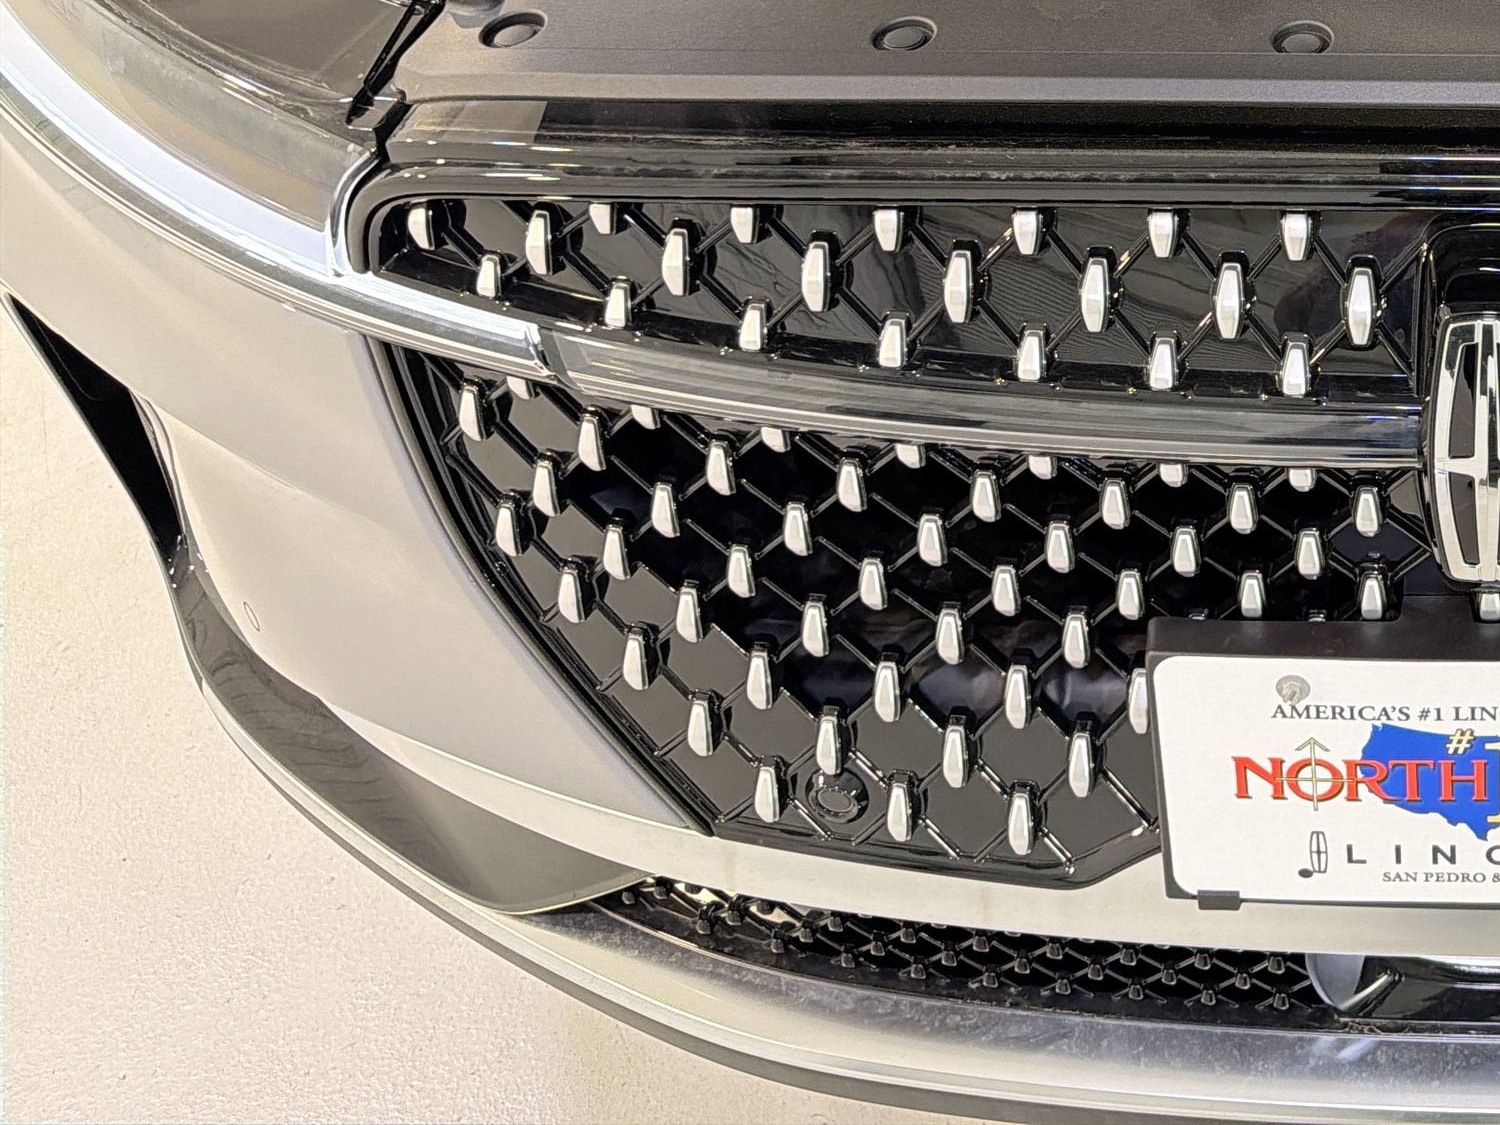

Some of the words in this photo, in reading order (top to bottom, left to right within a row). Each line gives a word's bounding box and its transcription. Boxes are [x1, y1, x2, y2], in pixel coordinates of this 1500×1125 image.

[1271, 704, 1411, 722] AMERICA'S
[1418, 707, 1445, 722] #1
[1232, 755, 1490, 803] NORTH
[1382, 871, 1421, 883] SAN
[1424, 871, 1487, 884] PEDRO
